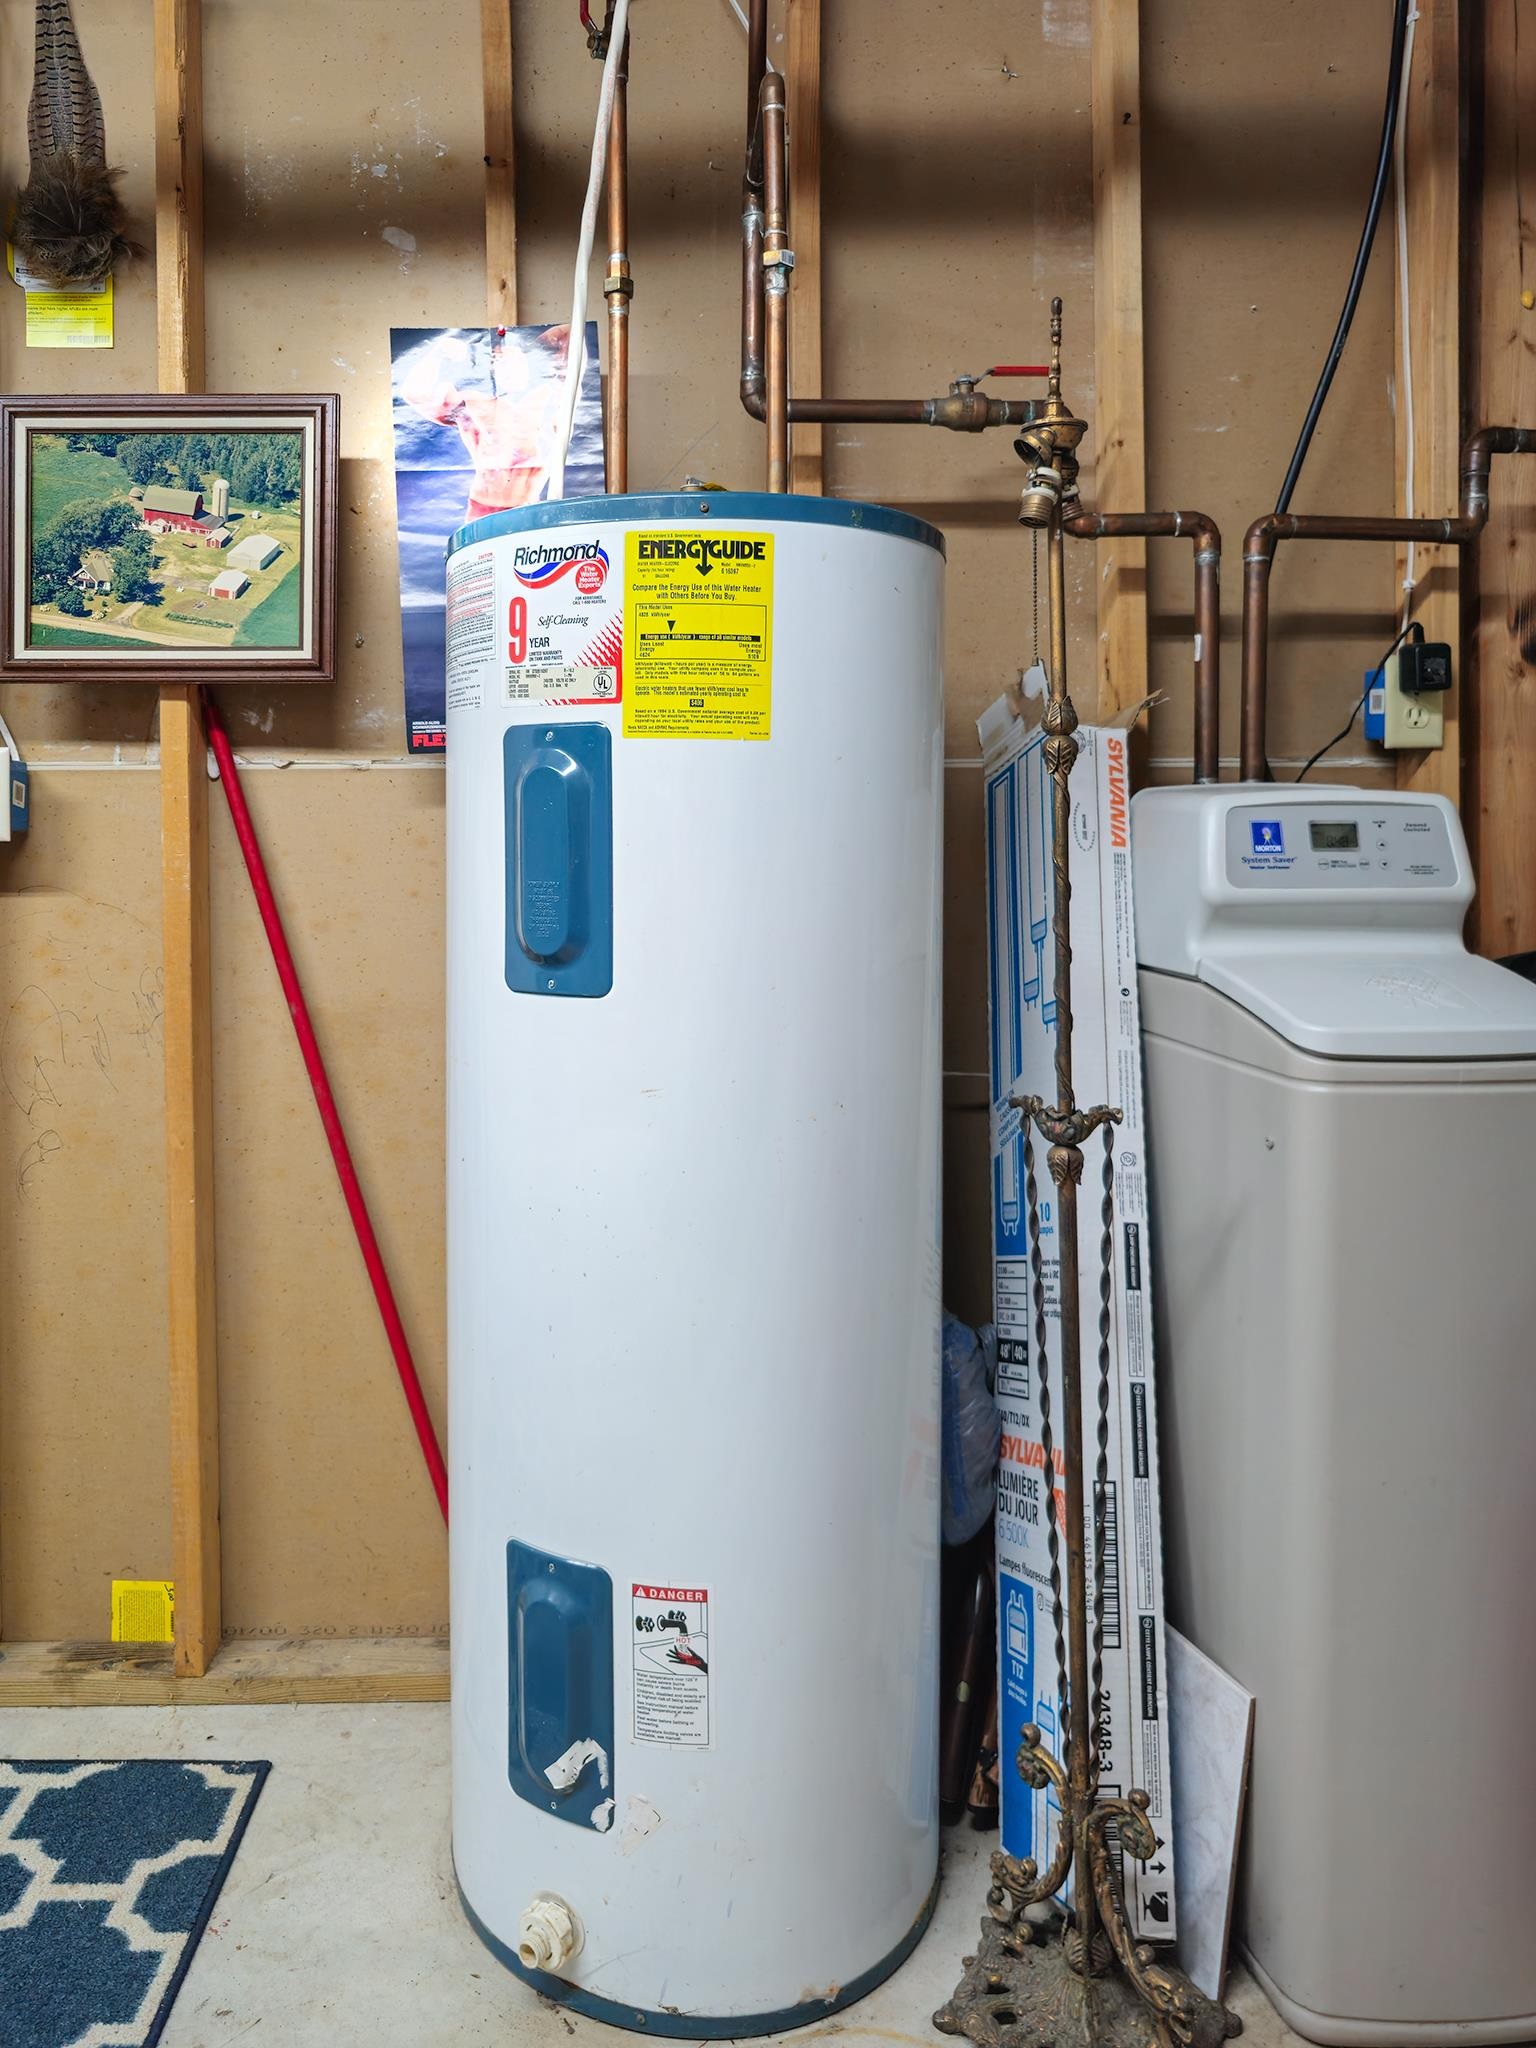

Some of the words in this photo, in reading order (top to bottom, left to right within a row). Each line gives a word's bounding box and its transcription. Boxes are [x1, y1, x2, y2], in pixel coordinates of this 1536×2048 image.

[514, 540, 600, 566] Richmond
[638, 540, 766, 560] ENERGYGUIDE
[509, 597, 527, 664] 9
[538, 614, 589, 629] Self-Cleaning
[529, 637, 550, 648] YEAR
[1107, 737, 1126, 848] SYLVANIA
[1040, 1202, 1050, 1222] 10
[998, 1470, 1038, 1499] LUMIÈRE
[999, 1493, 1011, 1515] DU
[1015, 1498, 1038, 1526] JOUR
[999, 1553, 1021, 1574] Lampes
[650, 1588, 703, 1601] DANGER
[1012, 1660, 1024, 1680] T12
